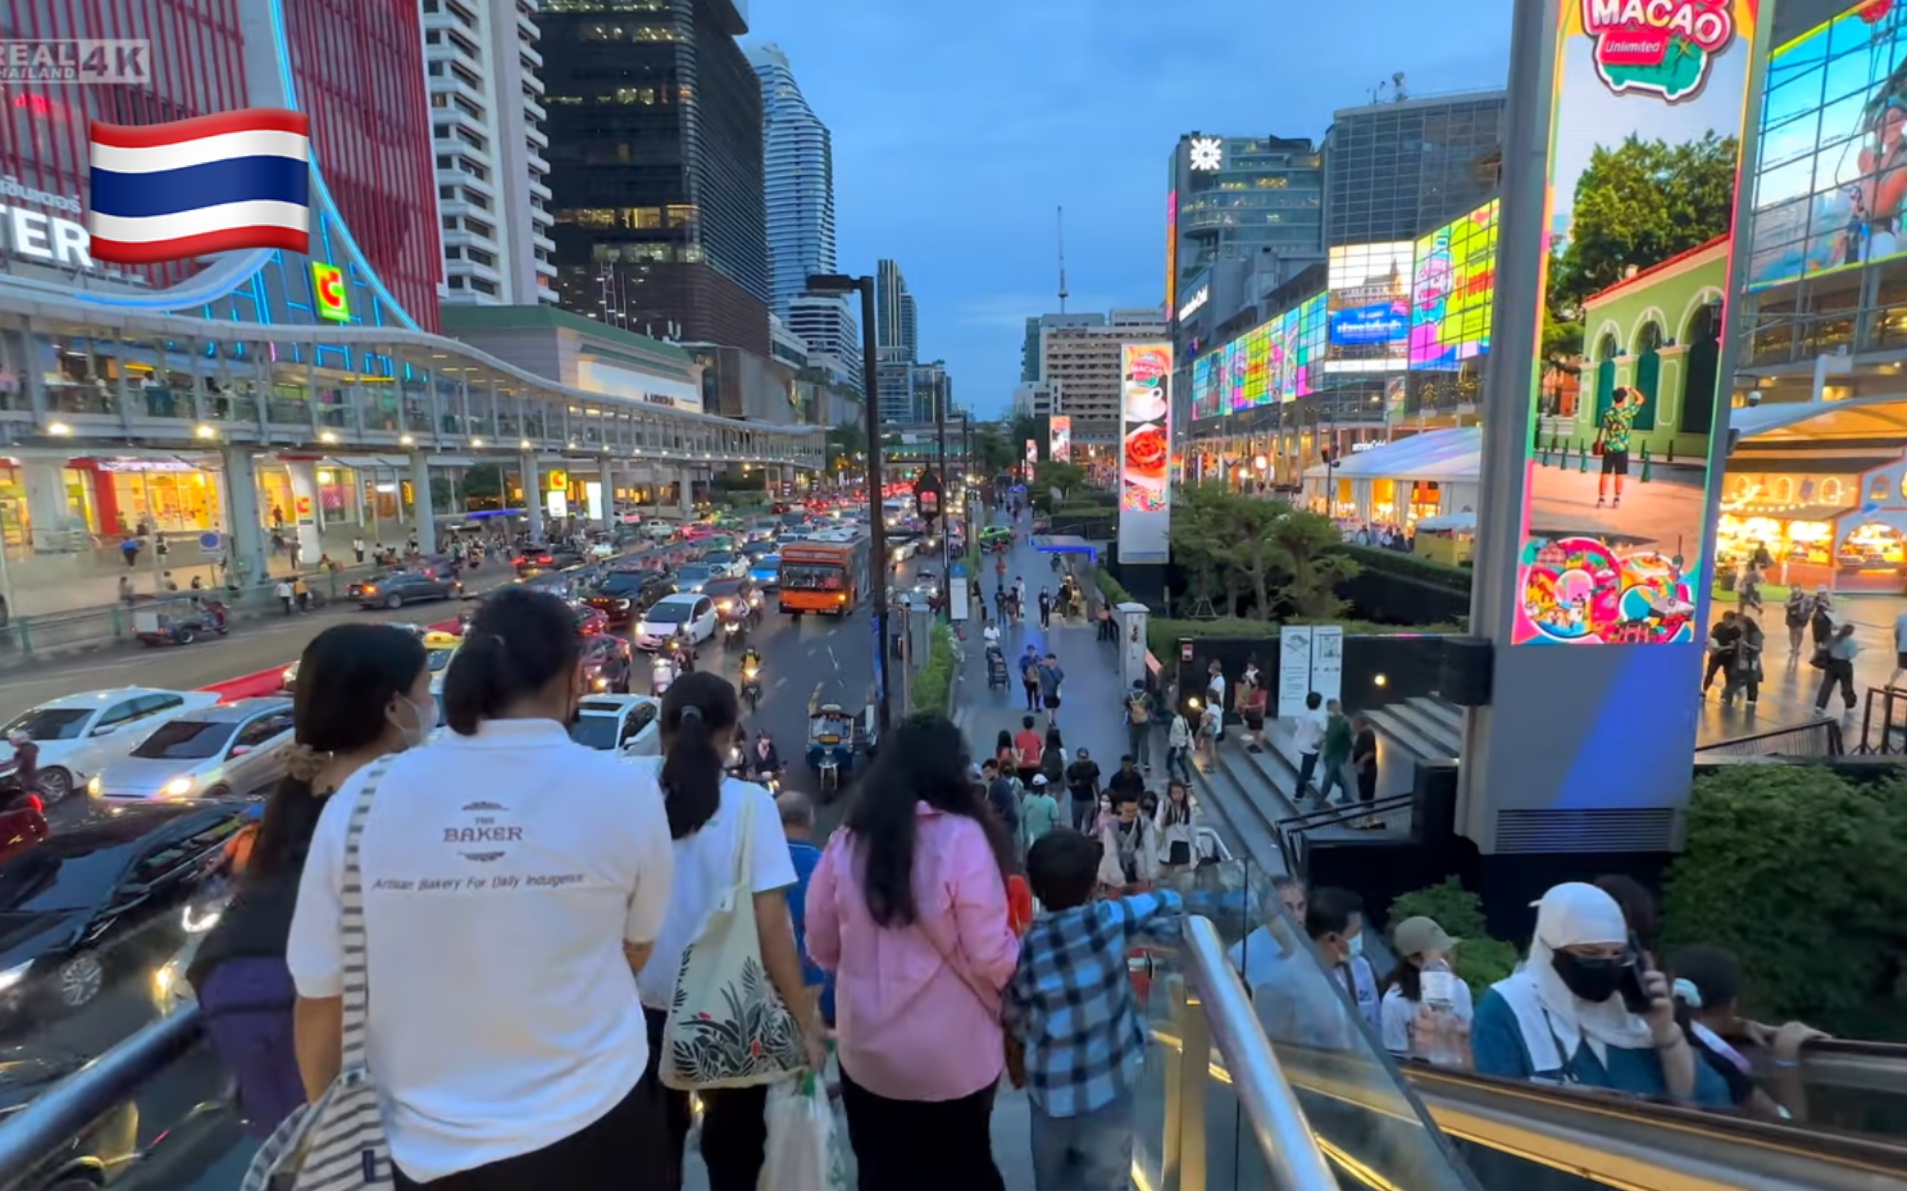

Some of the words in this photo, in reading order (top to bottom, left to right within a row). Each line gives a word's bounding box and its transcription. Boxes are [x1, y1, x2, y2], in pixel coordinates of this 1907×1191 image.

[1591, 0, 1722, 44] MACAO
[1605, 40, 1660, 53] Unlimited
[0, 204, 94, 268] ER
[443, 826, 523, 842] BAKER
[372, 878, 414, 890] Artisan
[418, 877, 462, 891] Bakery
[467, 877, 486, 889] For
[492, 875, 520, 889] Daily
